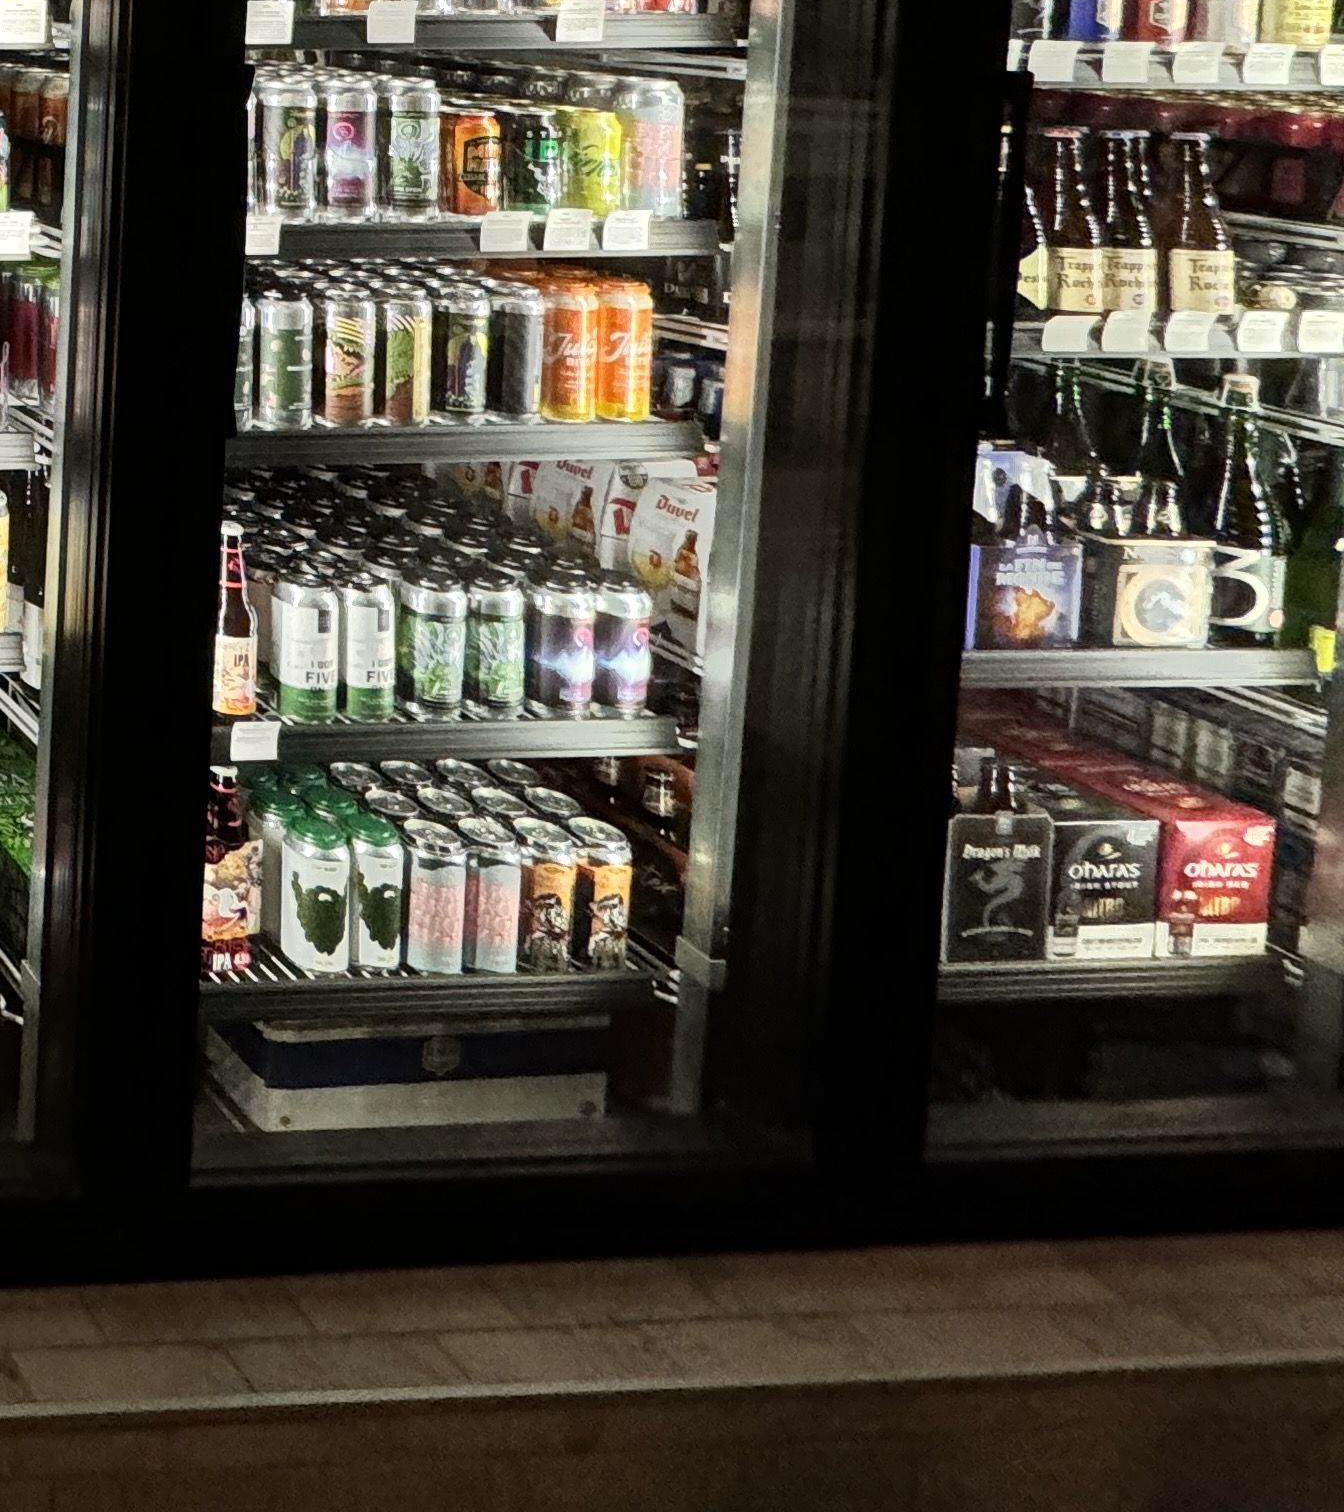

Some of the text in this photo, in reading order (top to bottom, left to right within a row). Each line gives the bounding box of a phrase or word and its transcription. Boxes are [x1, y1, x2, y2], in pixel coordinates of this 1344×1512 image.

[556, 461, 598, 481] Duvel
[655, 494, 701, 524] Duvel
[234, 653, 251, 668] IPA
[213, 952, 233, 970] IPA
